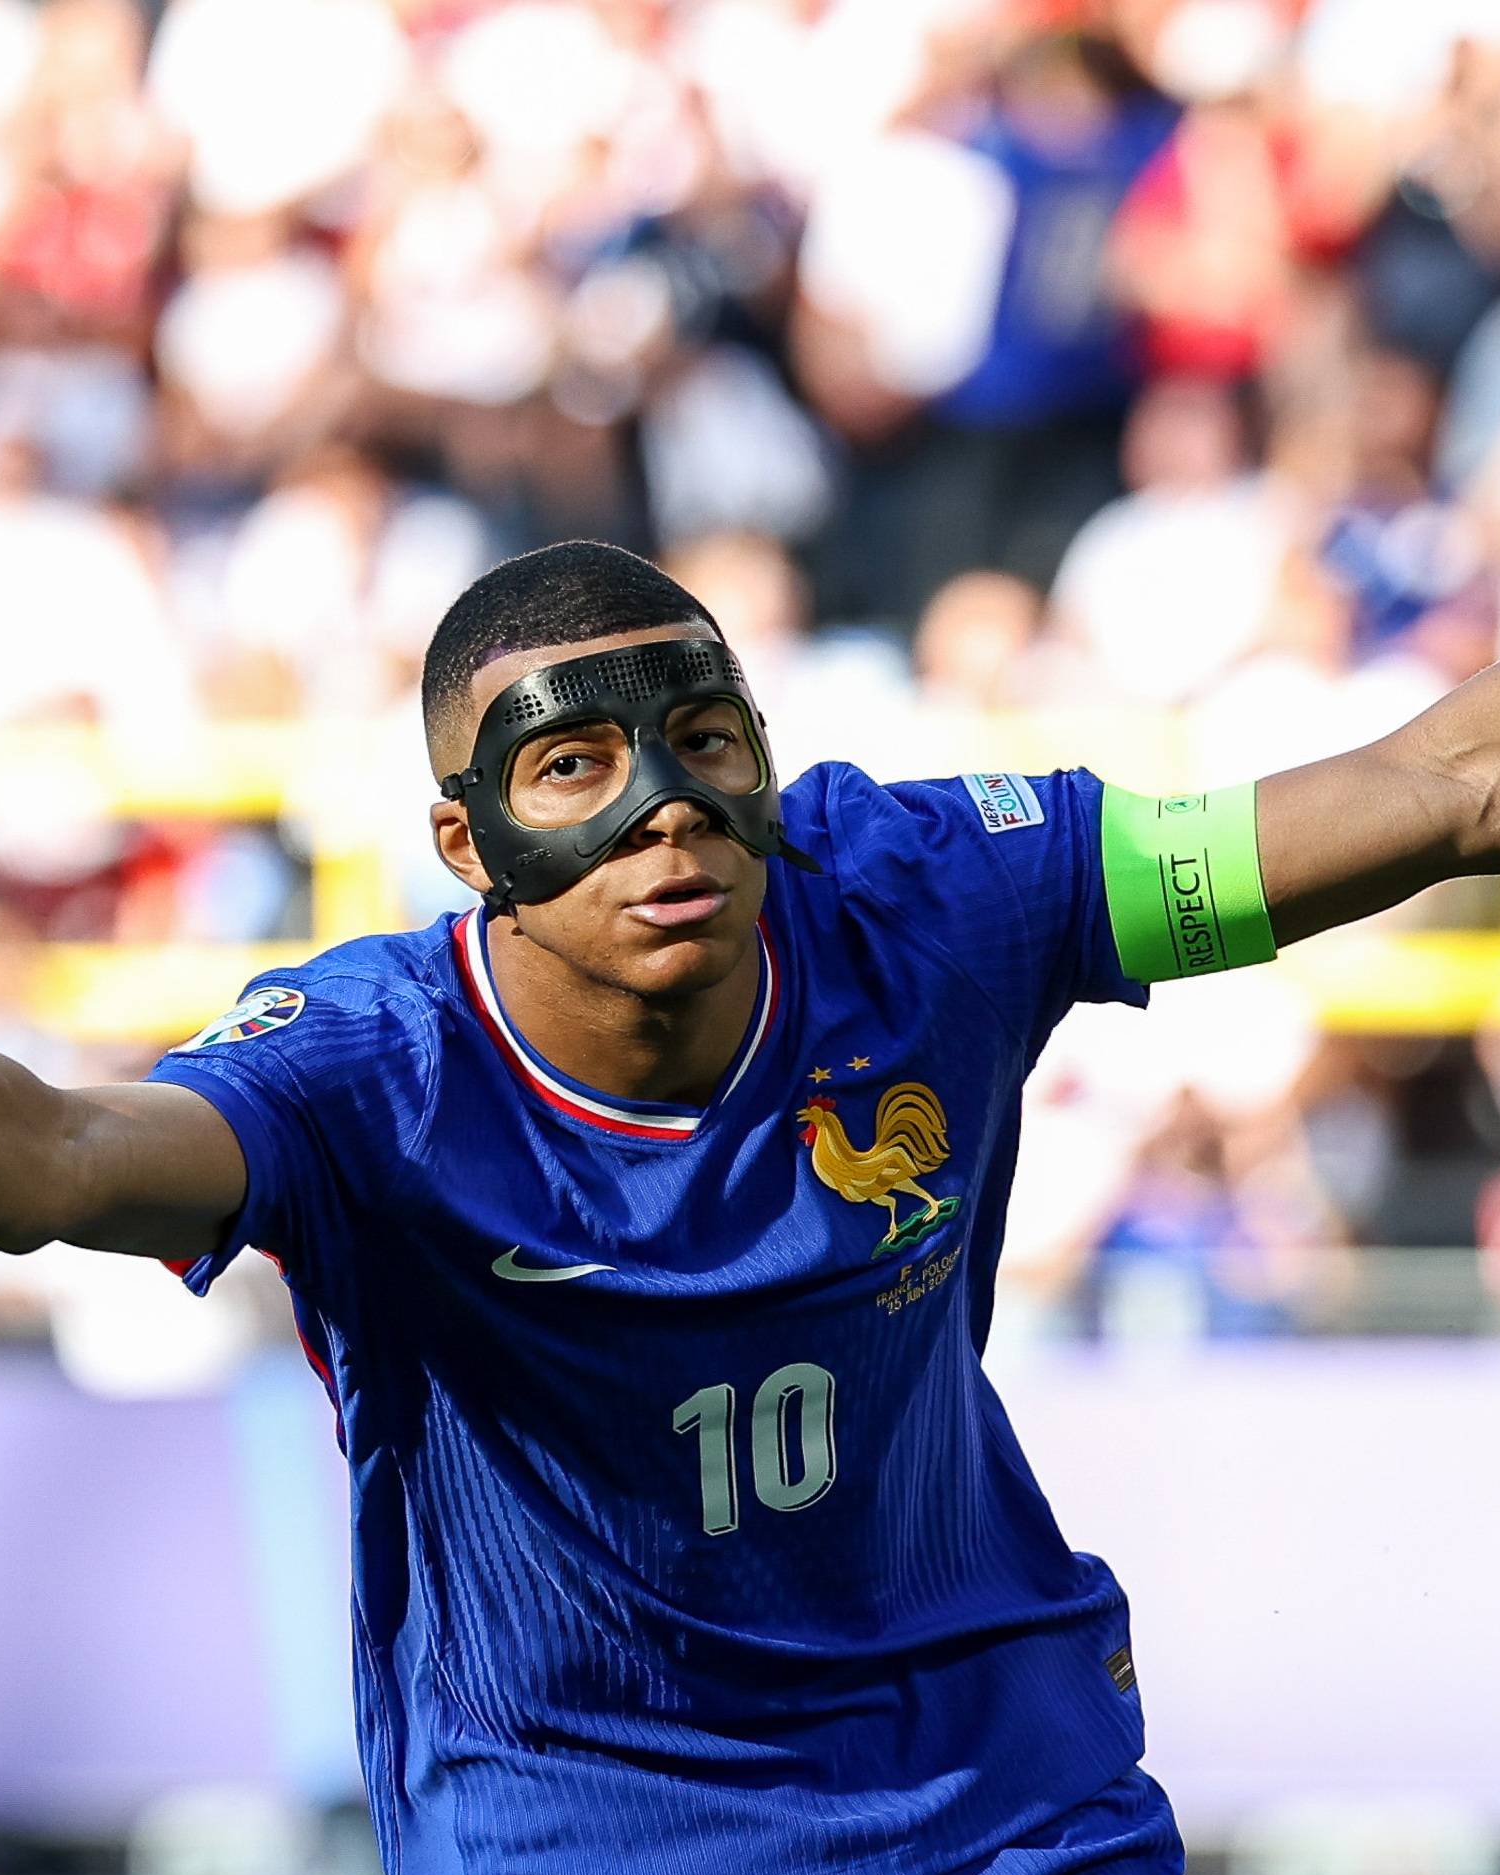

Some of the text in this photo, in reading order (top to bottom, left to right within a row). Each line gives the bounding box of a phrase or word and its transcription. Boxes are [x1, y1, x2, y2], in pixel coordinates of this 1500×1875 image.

[982, 774, 1024, 825] FOUN
[1170, 853, 1217, 968] RESPECT
[672, 1361, 837, 1537] 10
